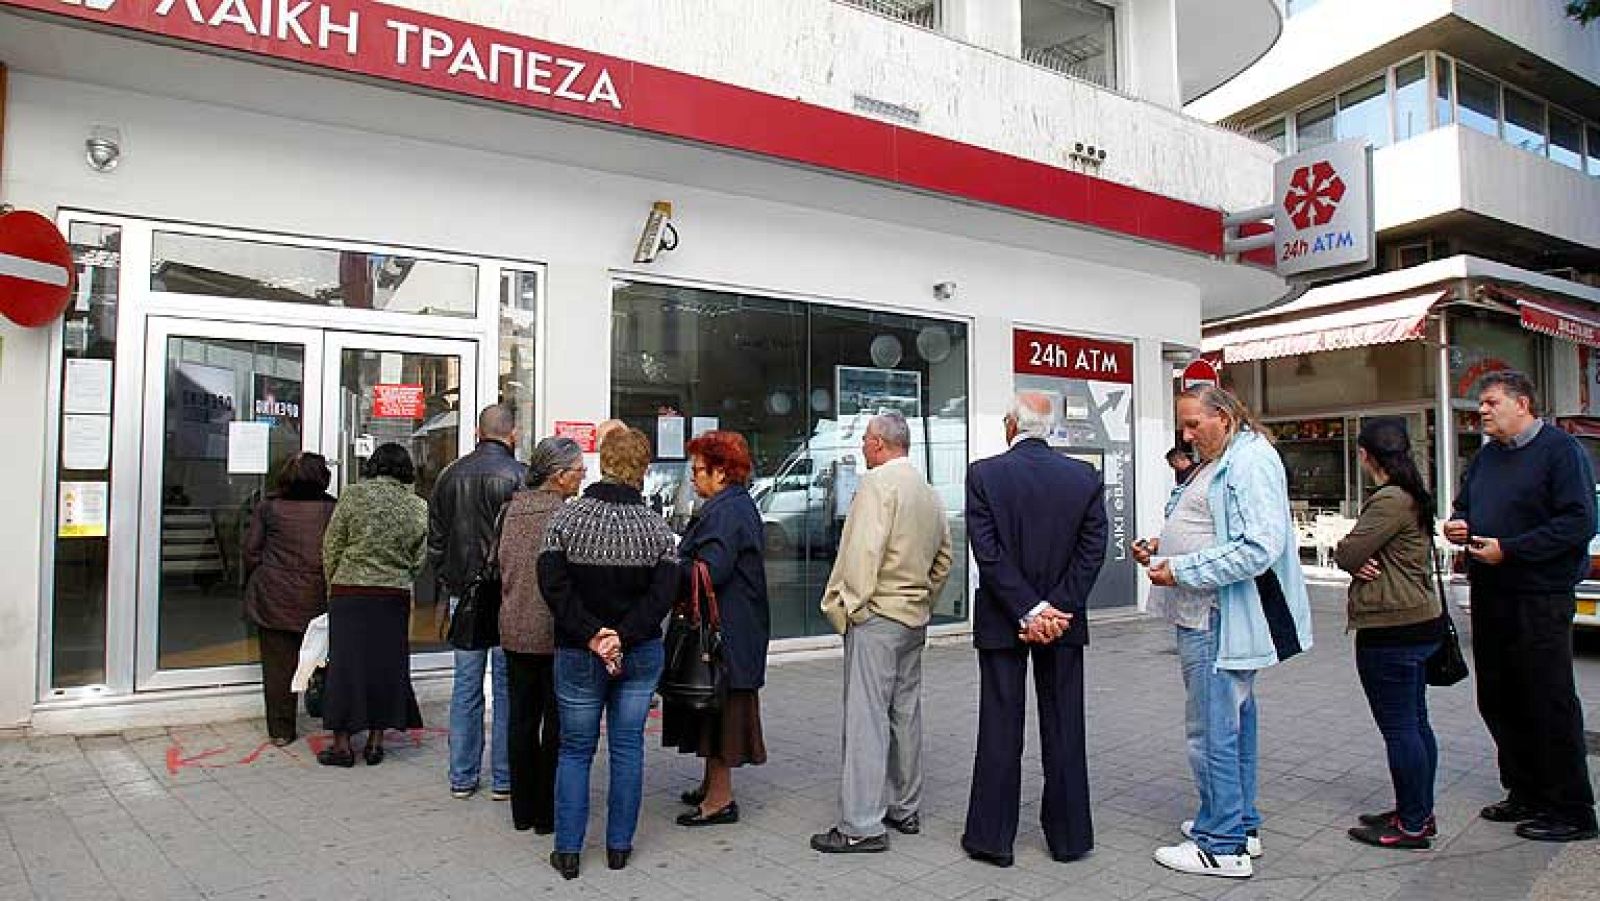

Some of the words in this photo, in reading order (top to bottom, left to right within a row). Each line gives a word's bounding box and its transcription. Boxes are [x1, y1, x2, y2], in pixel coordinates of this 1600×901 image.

[386, 19, 622, 110] ΤΡΑΠΕΖΑ
[1282, 239, 1309, 260] 24h
[1312, 230, 1353, 253] ATM
[1029, 341, 1067, 368] 24h
[1074, 348, 1118, 374] ATM
[1114, 516, 1126, 560] LAIKI
